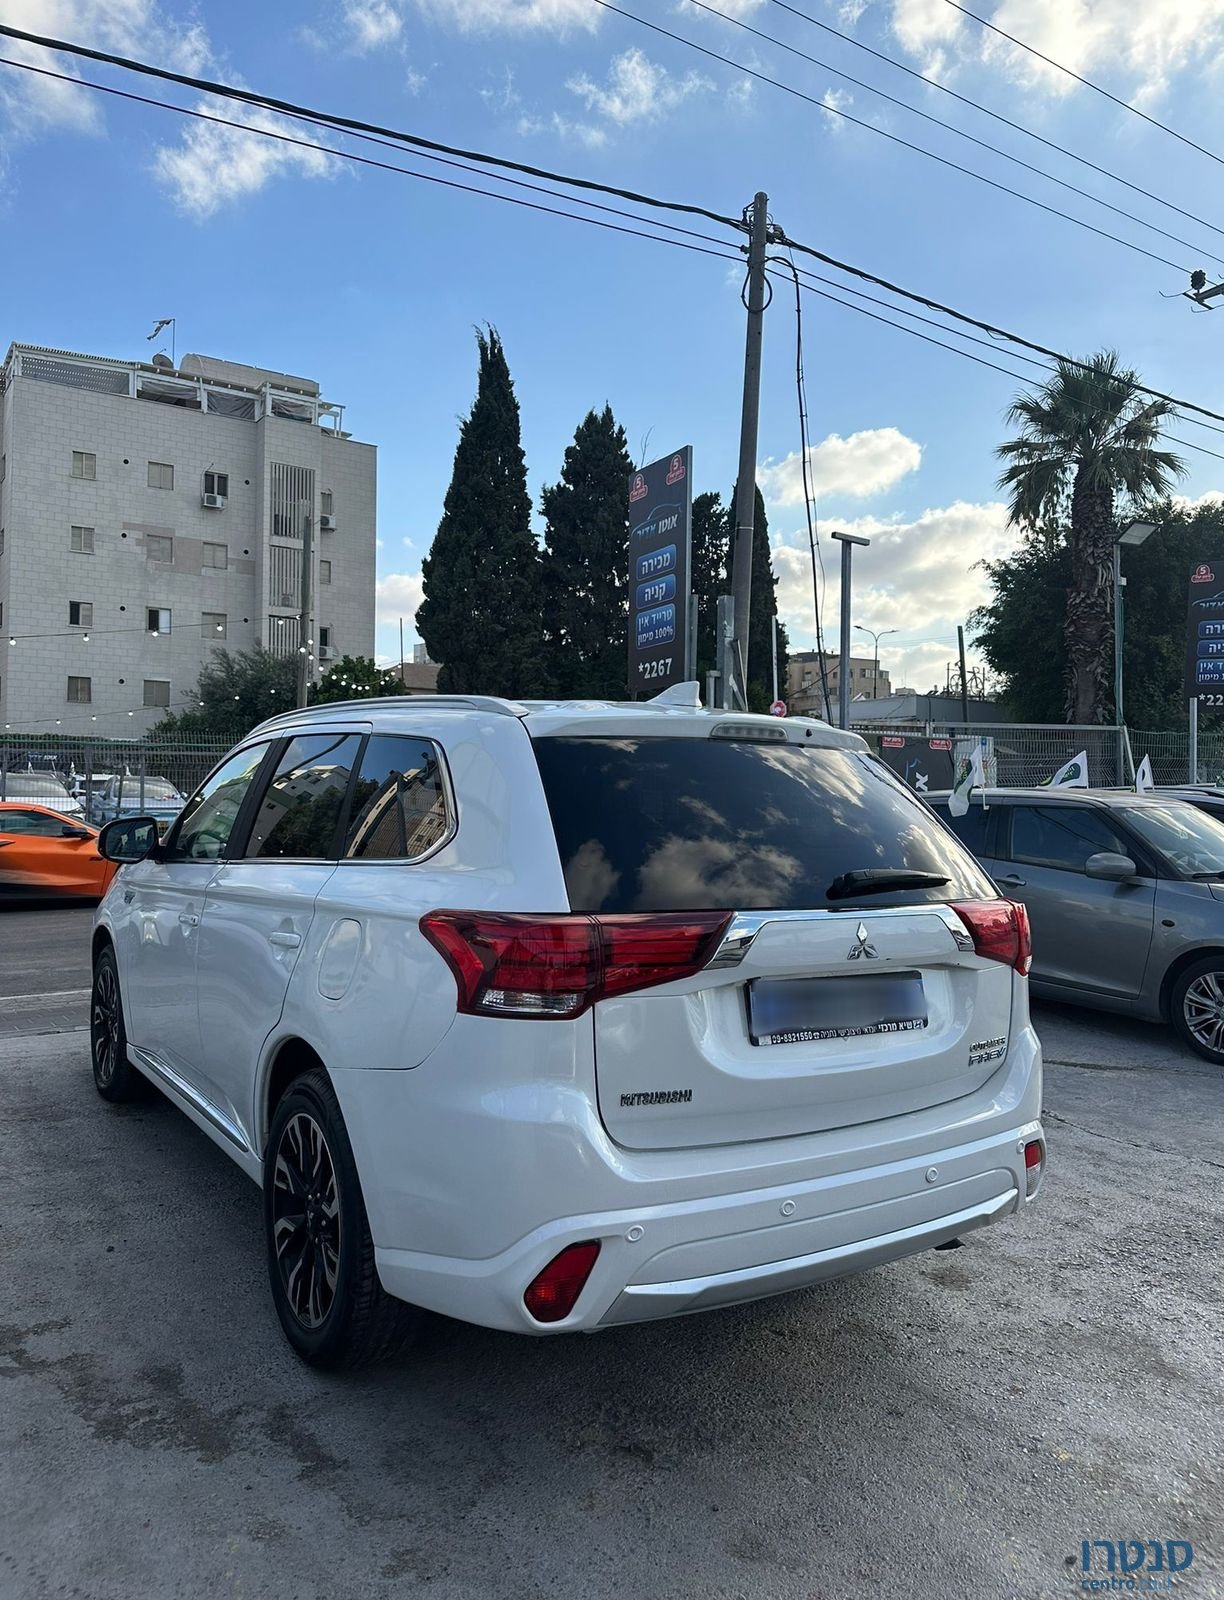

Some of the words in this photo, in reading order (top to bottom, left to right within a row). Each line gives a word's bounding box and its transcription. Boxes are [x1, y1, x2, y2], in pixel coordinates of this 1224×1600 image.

[658, 513, 679, 535] אוטו
[641, 552, 671, 575] מכירה
[644, 582, 666, 602] קניה
[638, 615, 650, 632] אין
[651, 608, 673, 625] טרייד
[637, 631, 654, 647] מימון
[655, 624, 674, 640] 100%
[1200, 662, 1214, 673] אין
[1198, 673, 1220, 683] מימון
[968, 1046, 1007, 1067] PHEV
[620, 1089, 693, 1107] MITSUBISHI
